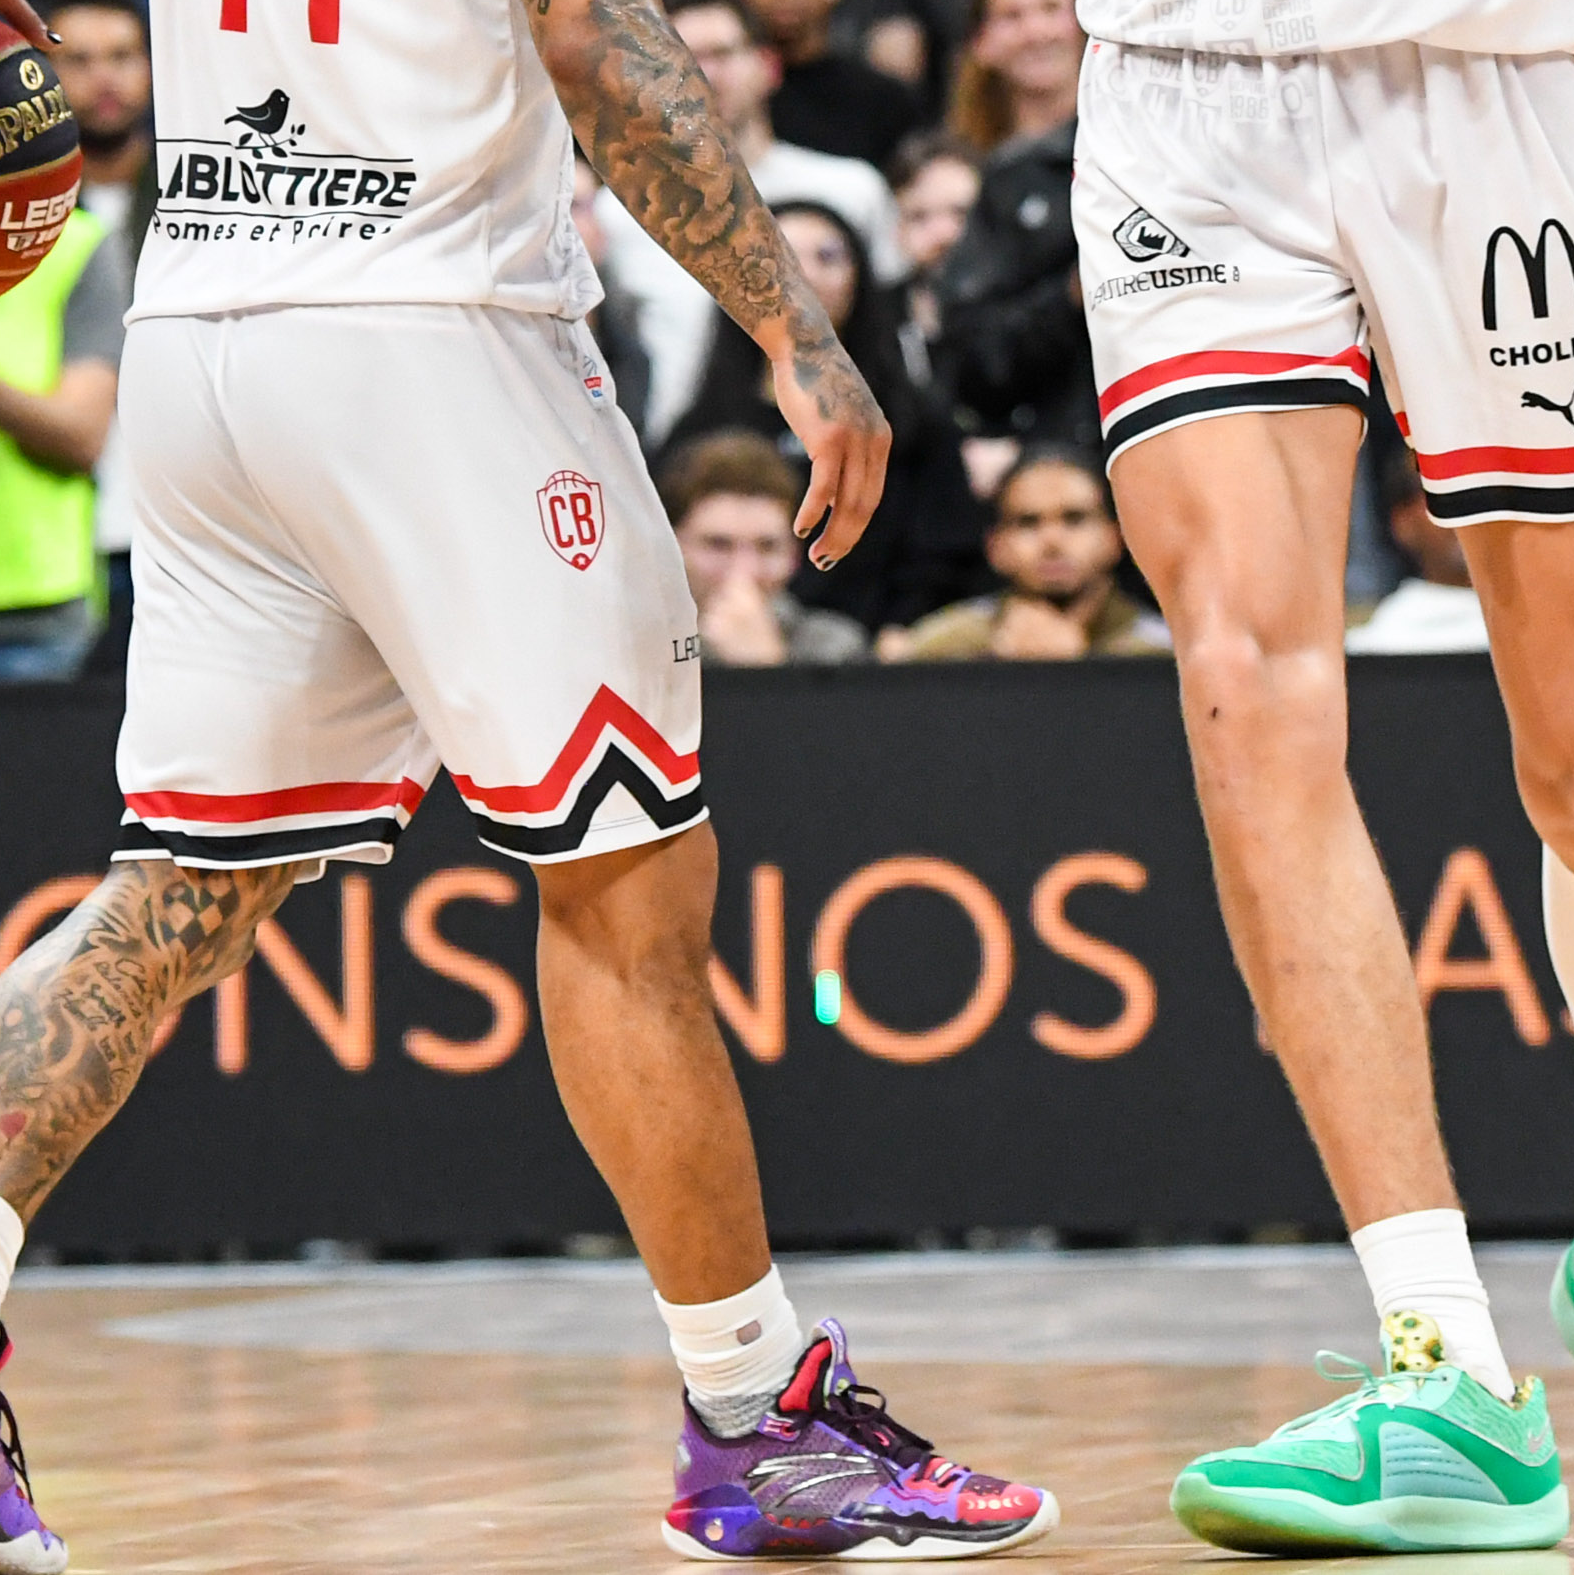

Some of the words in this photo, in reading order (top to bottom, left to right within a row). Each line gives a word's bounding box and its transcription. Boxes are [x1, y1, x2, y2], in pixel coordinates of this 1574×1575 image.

[157, 152, 417, 208] ABLOTTIERE
[250, 222, 282, 243] et
[549, 492, 598, 550] CB
